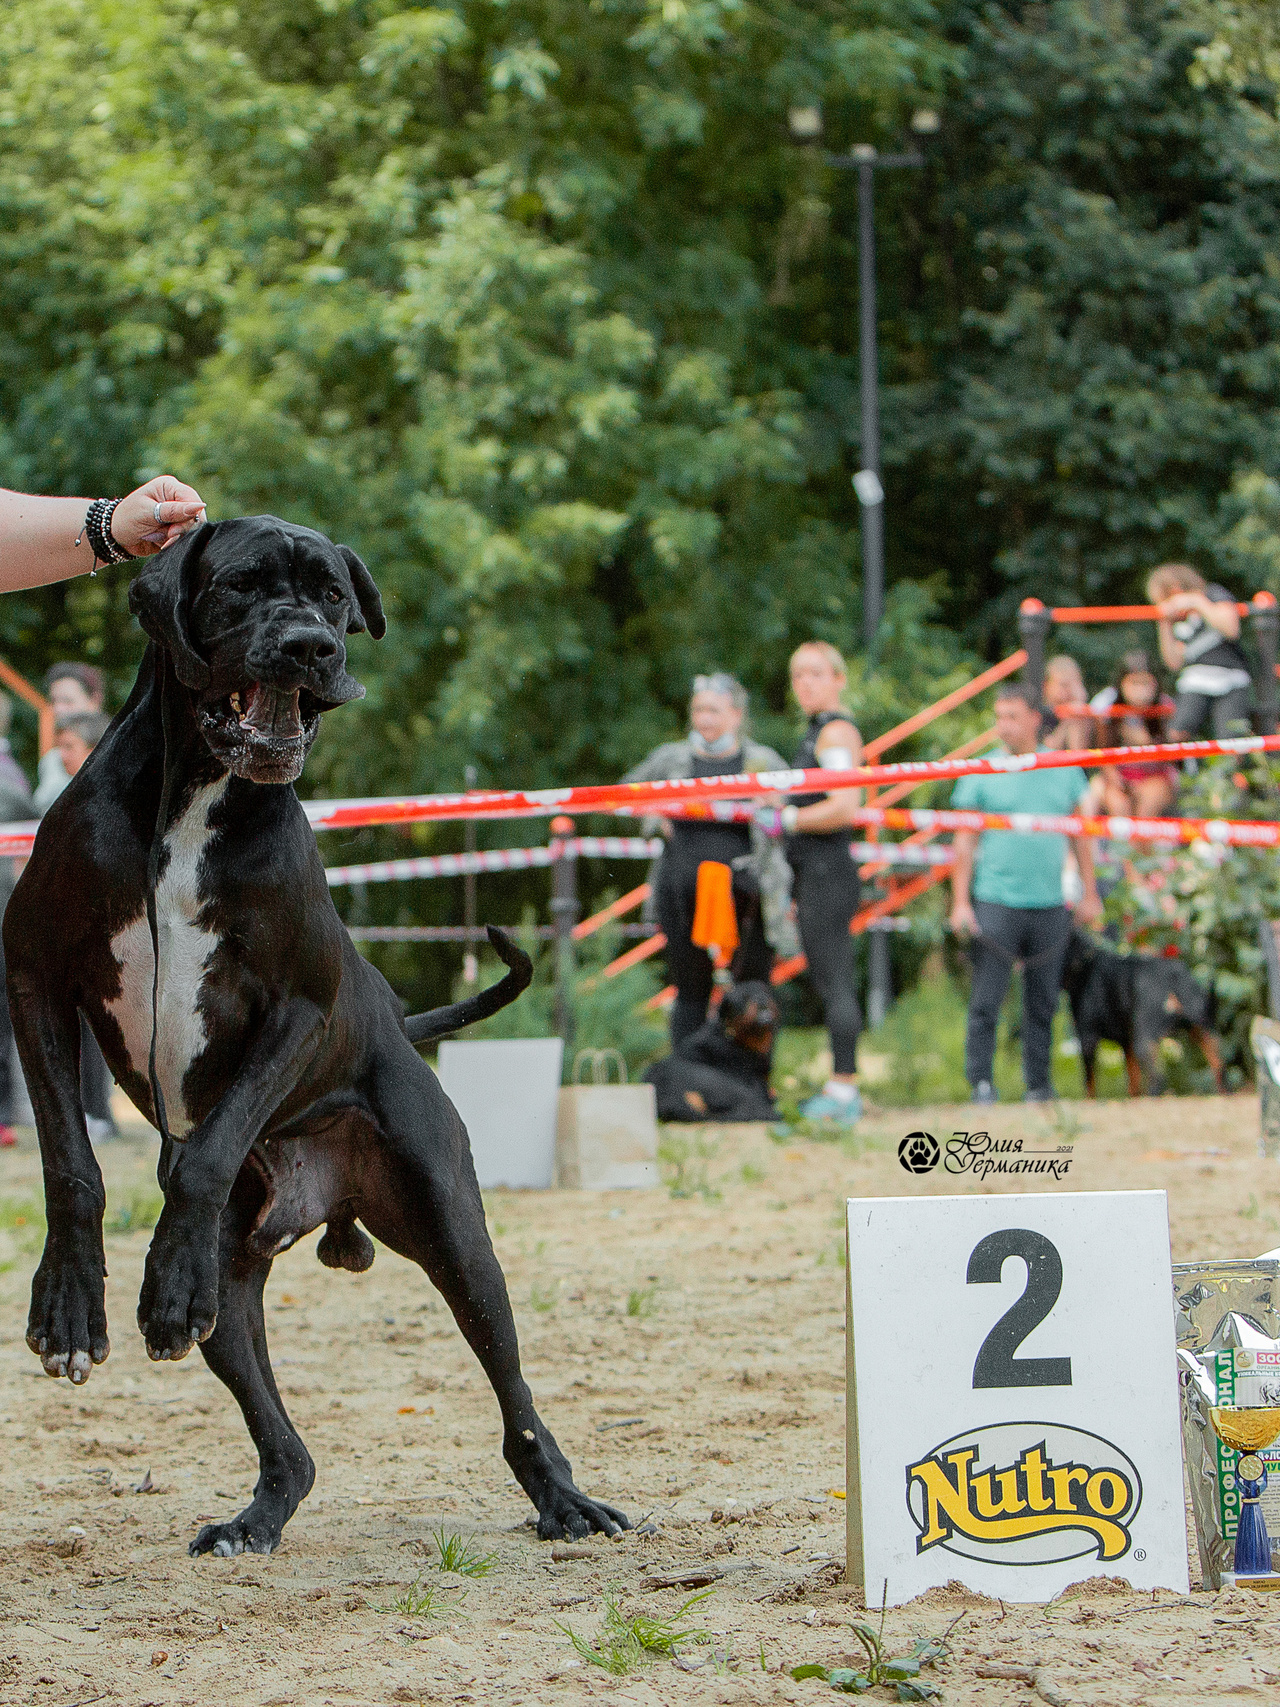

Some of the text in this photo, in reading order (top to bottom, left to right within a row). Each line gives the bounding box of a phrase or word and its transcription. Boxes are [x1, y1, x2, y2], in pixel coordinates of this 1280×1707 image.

[966, 1228, 1073, 1389] 2
[908, 1441, 1131, 1552] Nutro
[1218, 1353, 1238, 1537] ПРОФЕСОНАЛ
